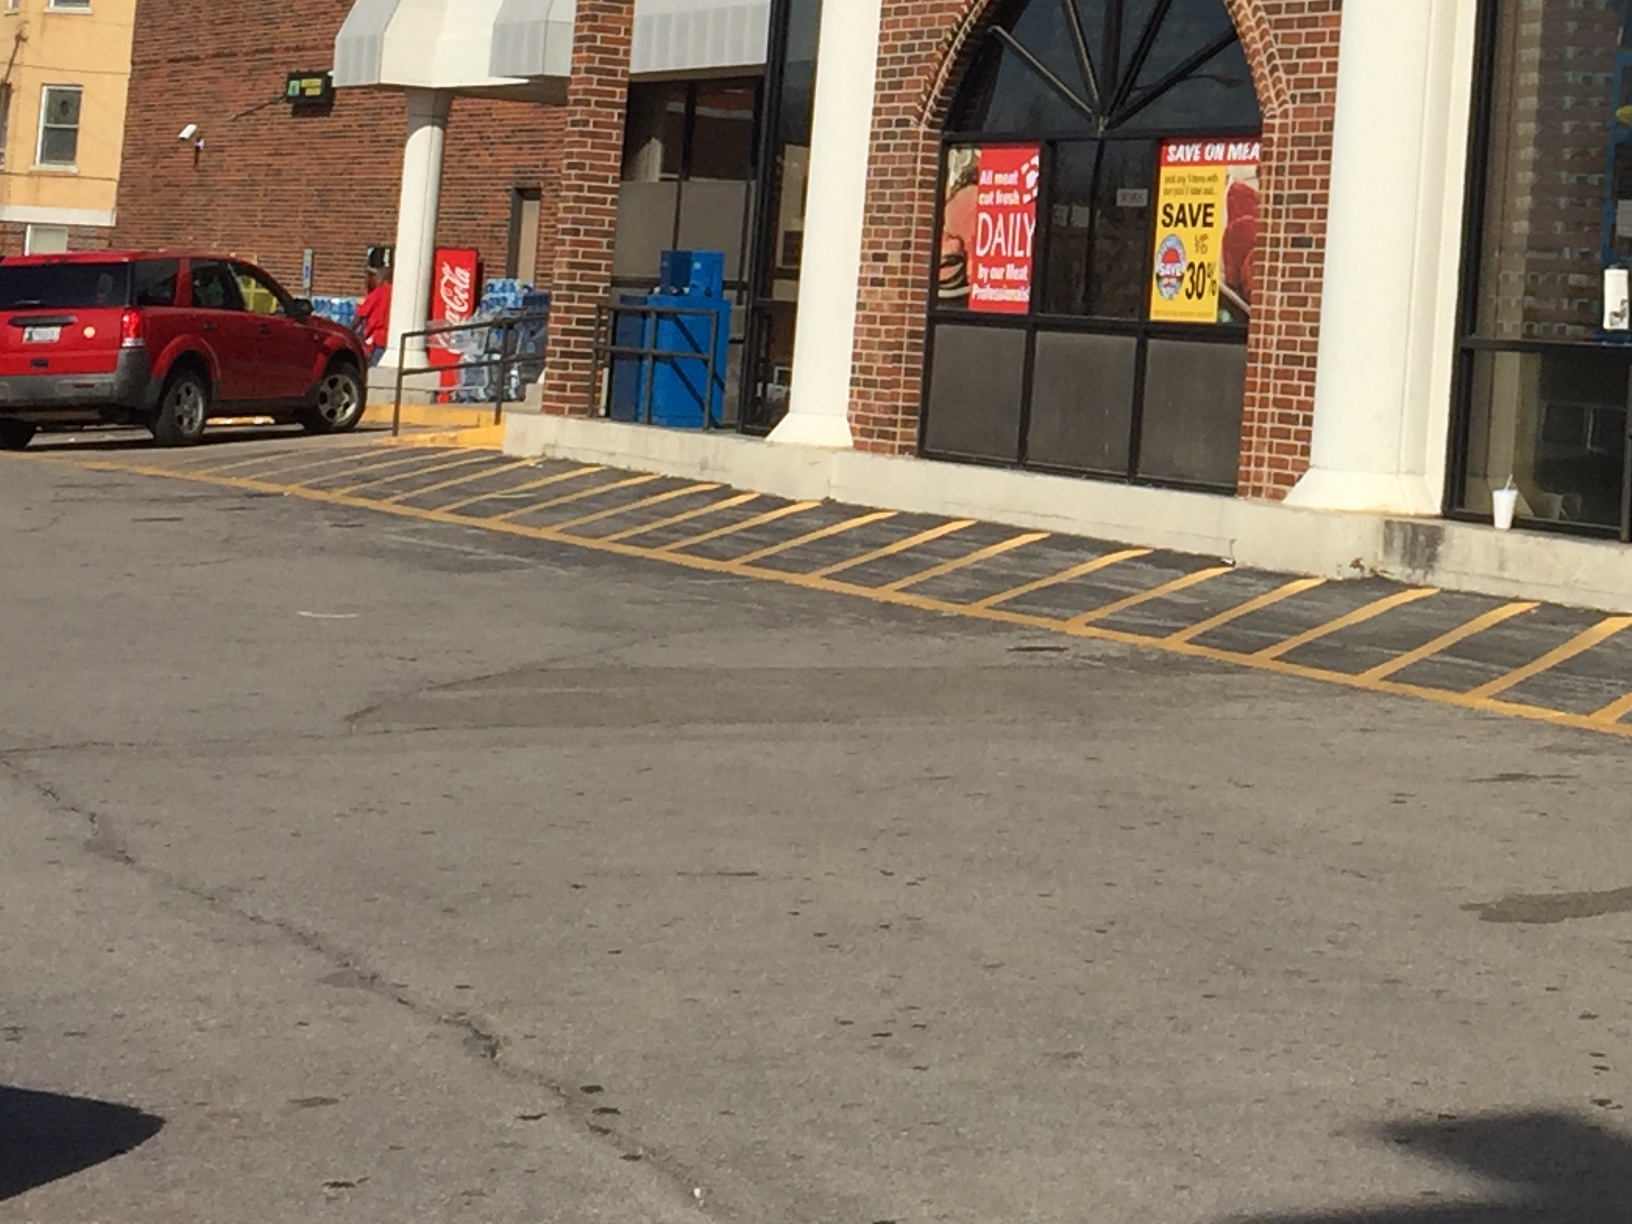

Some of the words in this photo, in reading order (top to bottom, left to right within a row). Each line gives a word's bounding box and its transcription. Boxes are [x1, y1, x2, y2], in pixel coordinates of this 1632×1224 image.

[1167, 142, 1203, 162] SAVE
[1204, 142, 1226, 161] ON
[1227, 142, 1262, 161] MEA
[1161, 202, 1216, 228] SAVE
[975, 212, 1036, 257] DAILY
